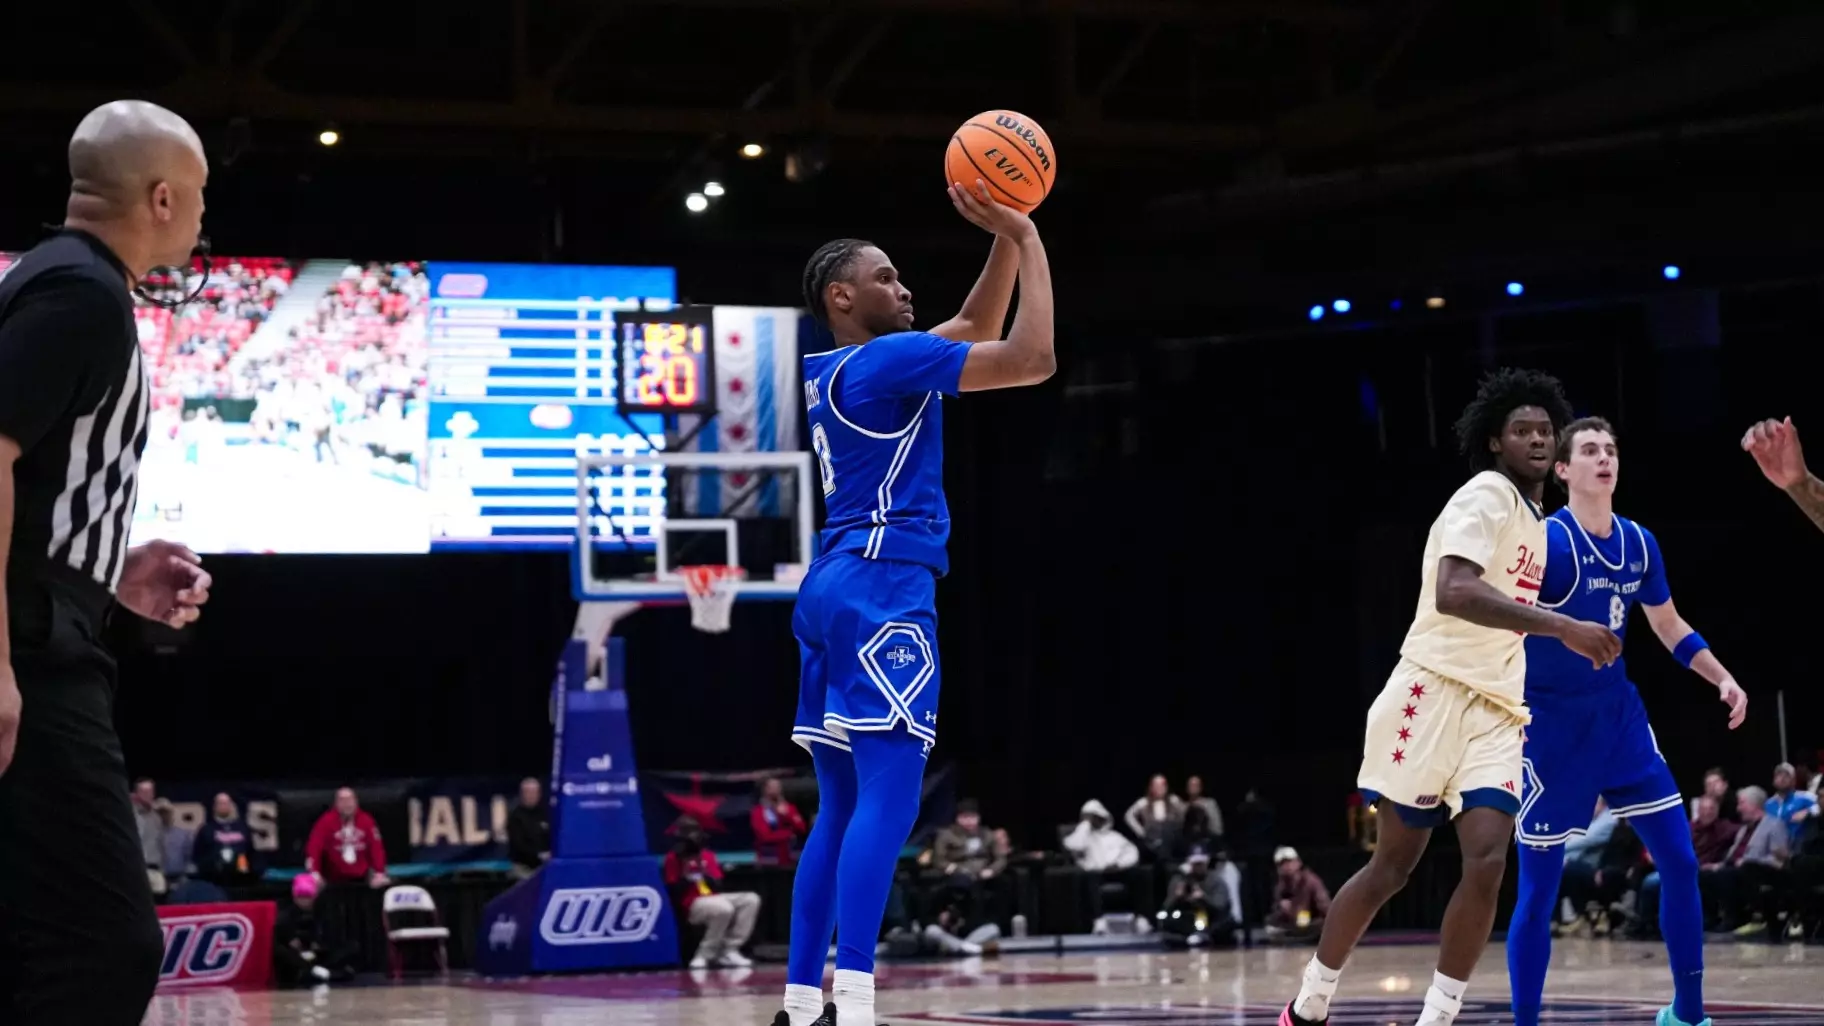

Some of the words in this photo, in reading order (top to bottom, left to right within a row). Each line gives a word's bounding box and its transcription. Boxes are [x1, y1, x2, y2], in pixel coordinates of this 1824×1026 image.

[984, 148, 1023, 182] EVO
[995, 114, 1050, 172] Wilson
[637, 353, 697, 406] 20
[550, 893, 652, 940] UIC
[158, 920, 244, 977] IC
